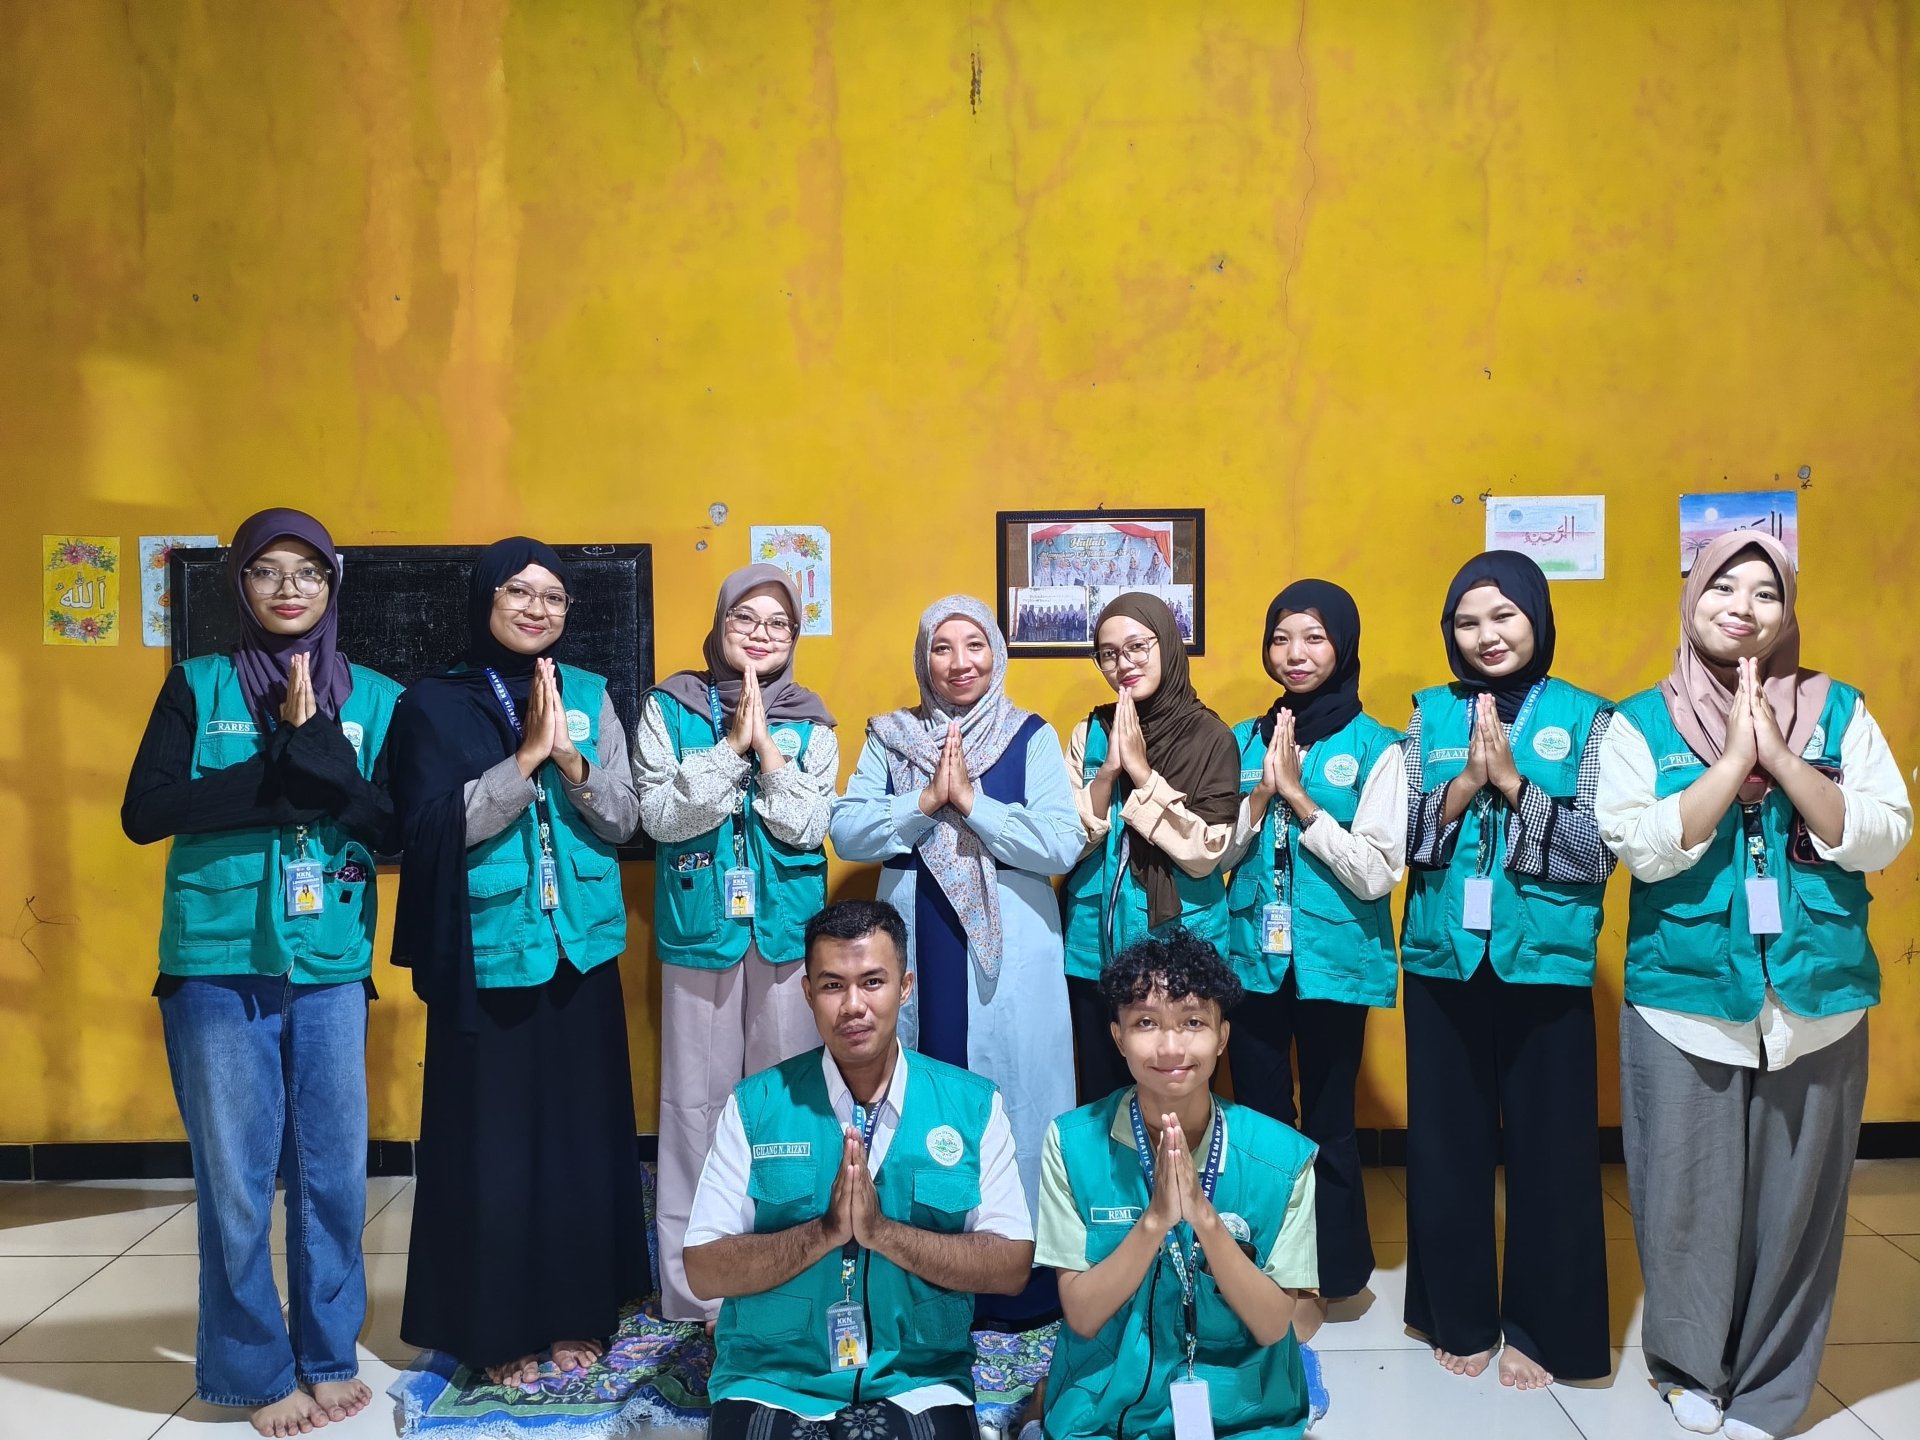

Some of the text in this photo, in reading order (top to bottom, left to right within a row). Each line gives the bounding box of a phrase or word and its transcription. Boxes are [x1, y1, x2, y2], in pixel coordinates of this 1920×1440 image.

[710, 686, 720, 712] TEMATIK
[1523, 686, 1541, 714] TEMATIK
[218, 723, 250, 731] RARES
[1511, 716, 1525, 746] KEMAWI
[786, 1144, 808, 1154] RIZKY
[1135, 1124, 1151, 1167] TEMATIK
[1210, 1125, 1221, 1164] KEMAWI
[1108, 1209, 1132, 1220] REMI
[837, 1316, 854, 1325] KKN
